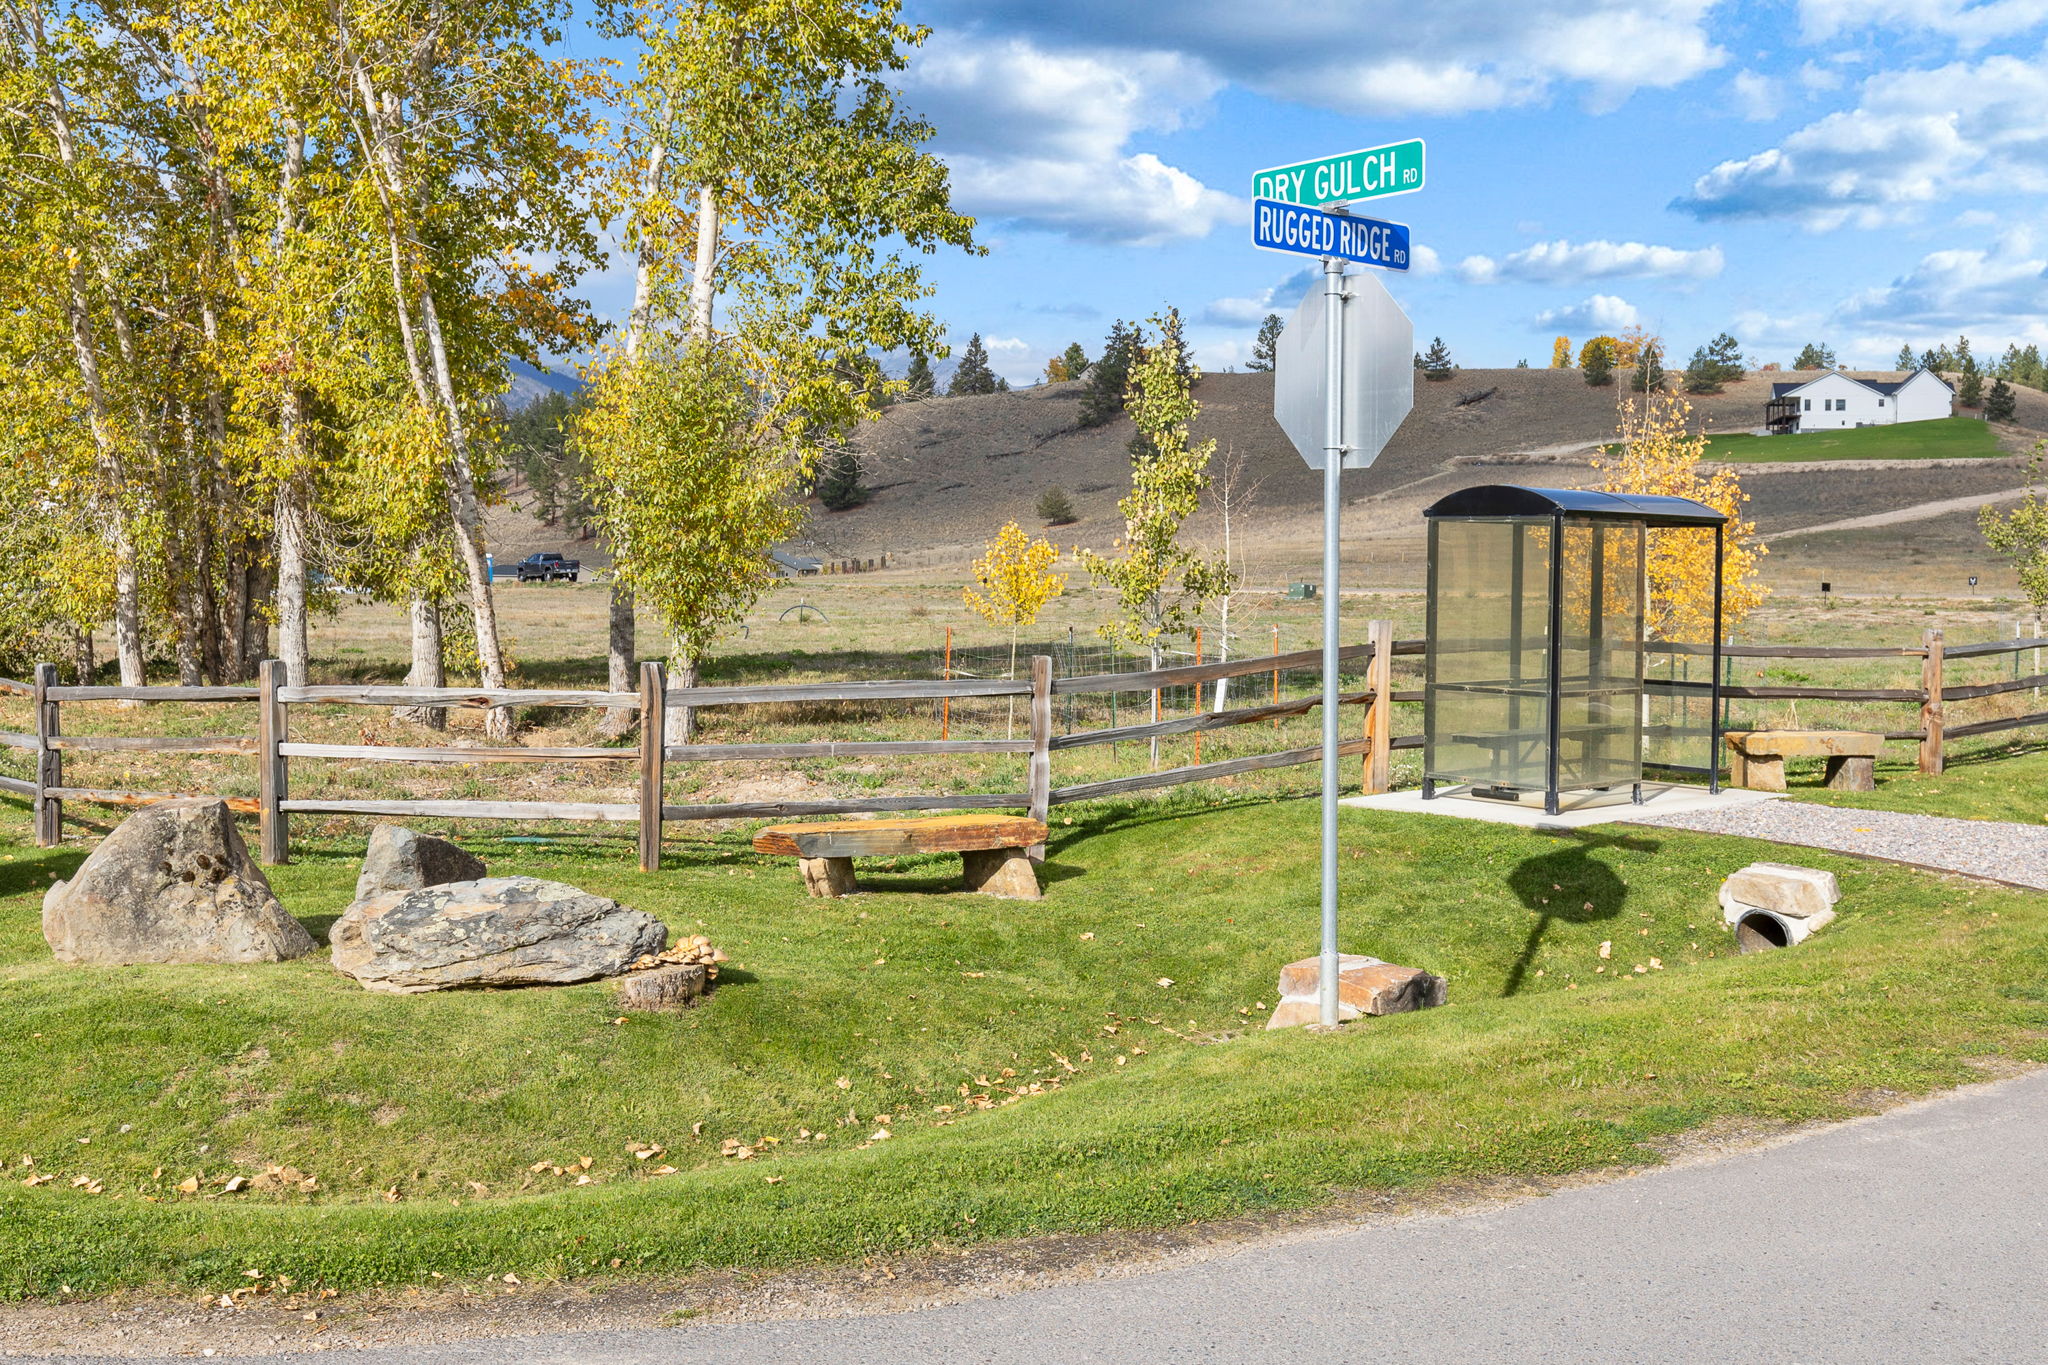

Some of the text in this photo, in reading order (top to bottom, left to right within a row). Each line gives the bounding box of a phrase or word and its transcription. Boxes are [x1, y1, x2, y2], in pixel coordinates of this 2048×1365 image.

[1260, 151, 1418, 203] DRY GULCH RD
[1259, 205, 1406, 264] RUGGED RIDGE RD
